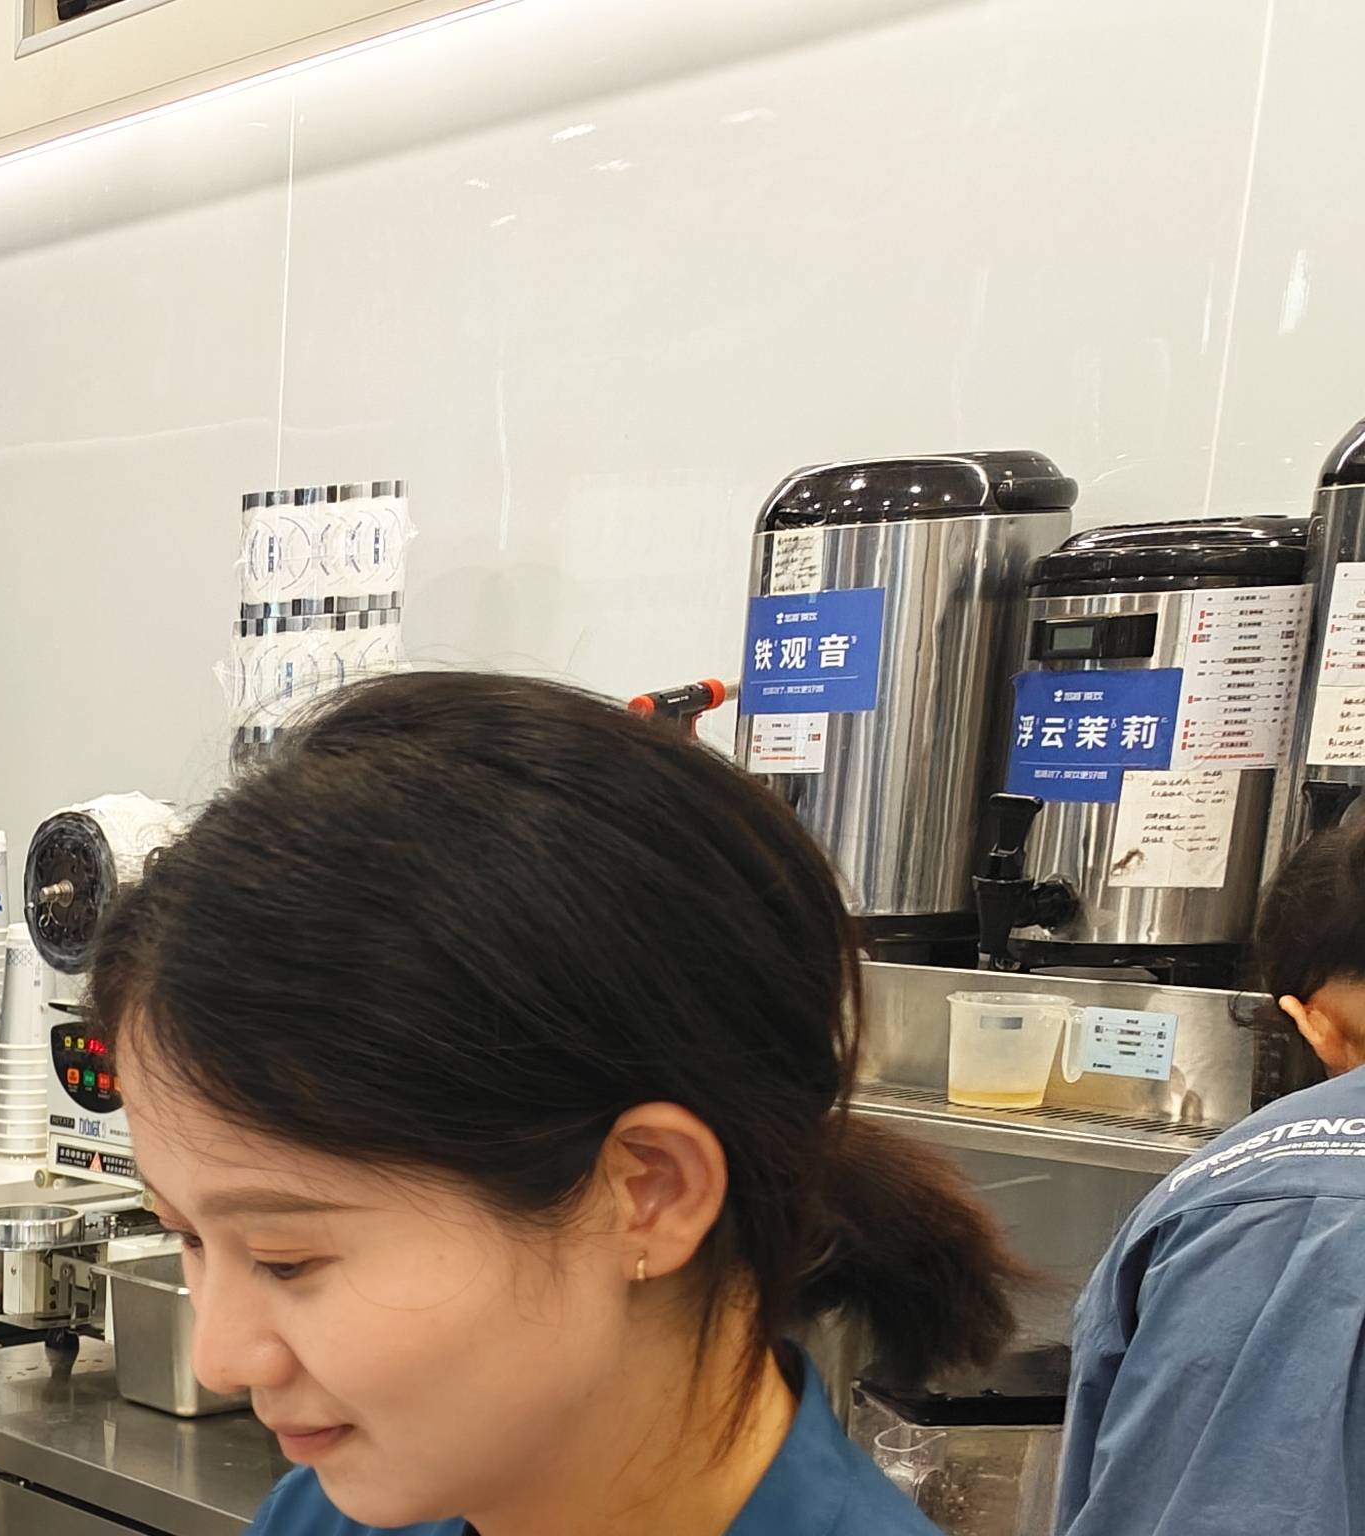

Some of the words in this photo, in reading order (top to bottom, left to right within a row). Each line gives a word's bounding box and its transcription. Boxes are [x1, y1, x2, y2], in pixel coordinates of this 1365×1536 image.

[754, 634, 849, 672] 铁观音
[1016, 714, 1160, 751] 浮云茉莉
